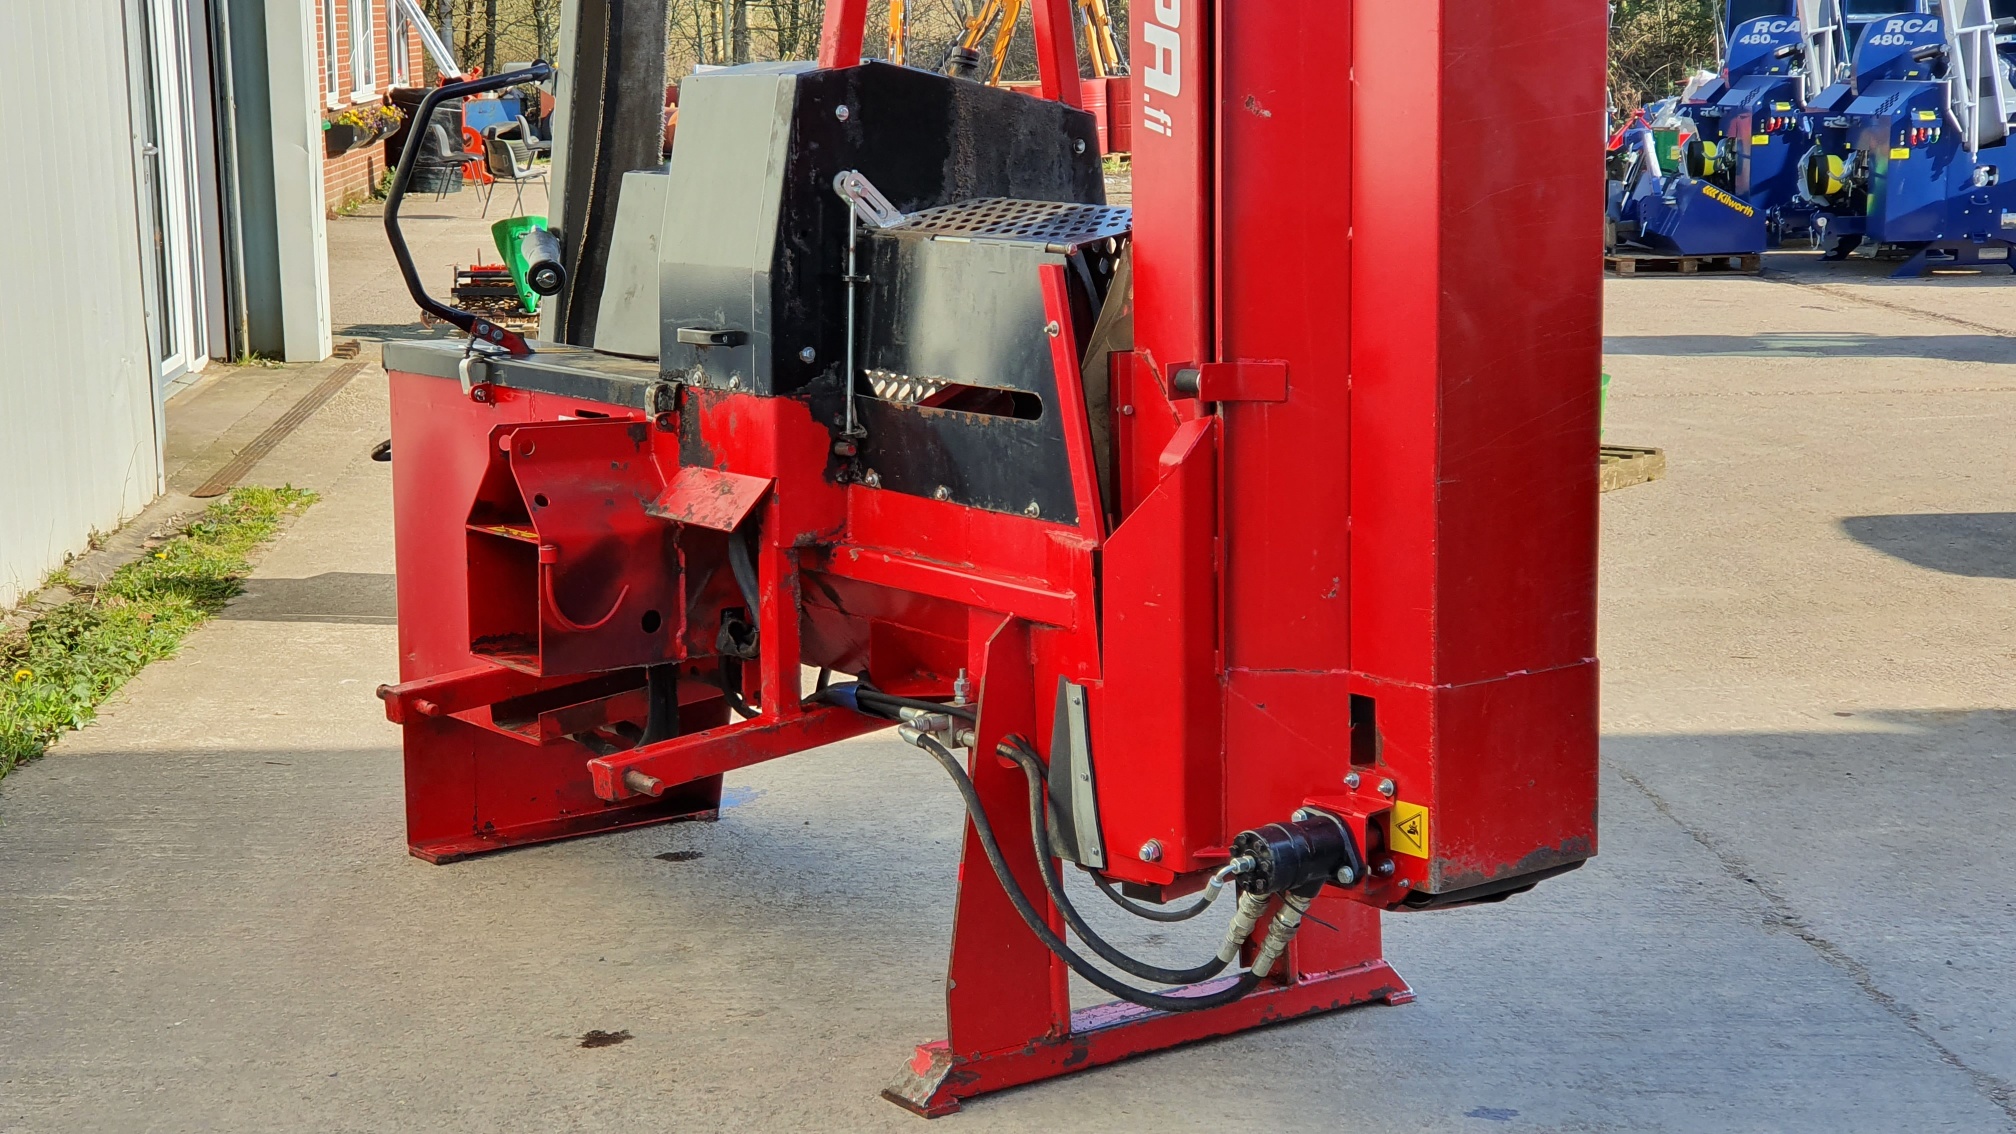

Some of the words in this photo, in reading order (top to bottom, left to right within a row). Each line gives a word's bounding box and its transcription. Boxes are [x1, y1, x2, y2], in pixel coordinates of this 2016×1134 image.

[1753, 20, 1801, 33] RCA
[1884, 19, 1939, 33] RCA
[1739, 34, 1771, 45] 480
[1869, 34, 1904, 45] 480
[1717, 192, 1754, 217] Kilworth
